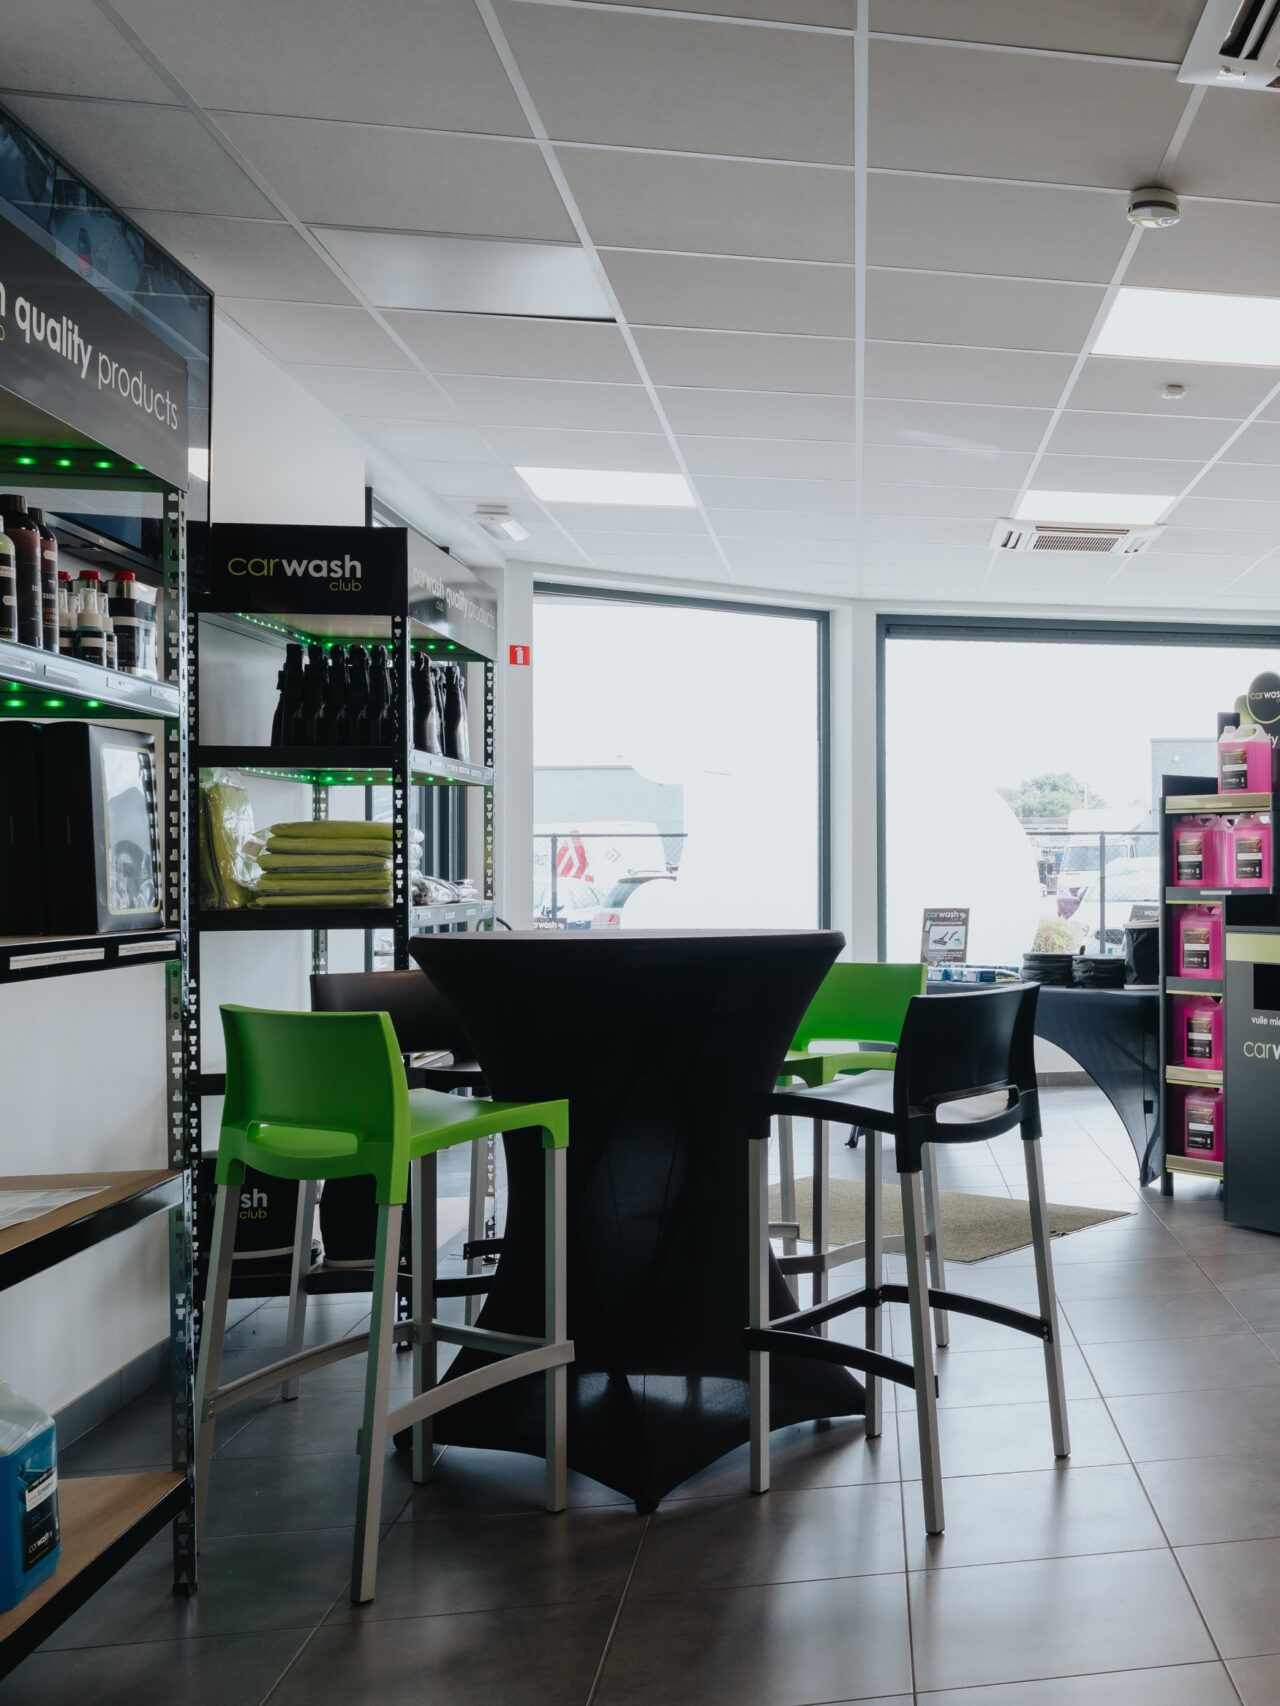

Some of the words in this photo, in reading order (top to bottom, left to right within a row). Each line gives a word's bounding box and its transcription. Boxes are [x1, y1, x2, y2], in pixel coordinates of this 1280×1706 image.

[15, 296, 92, 379] quality
[98, 352, 178, 430] products
[228, 554, 361, 578] carwash
[330, 579, 362, 592] club
[446, 587, 468, 618] quality
[925, 910, 959, 918] carwash
[1252, 1015, 1268, 1025] vuile
[239, 1209, 267, 1220] club
